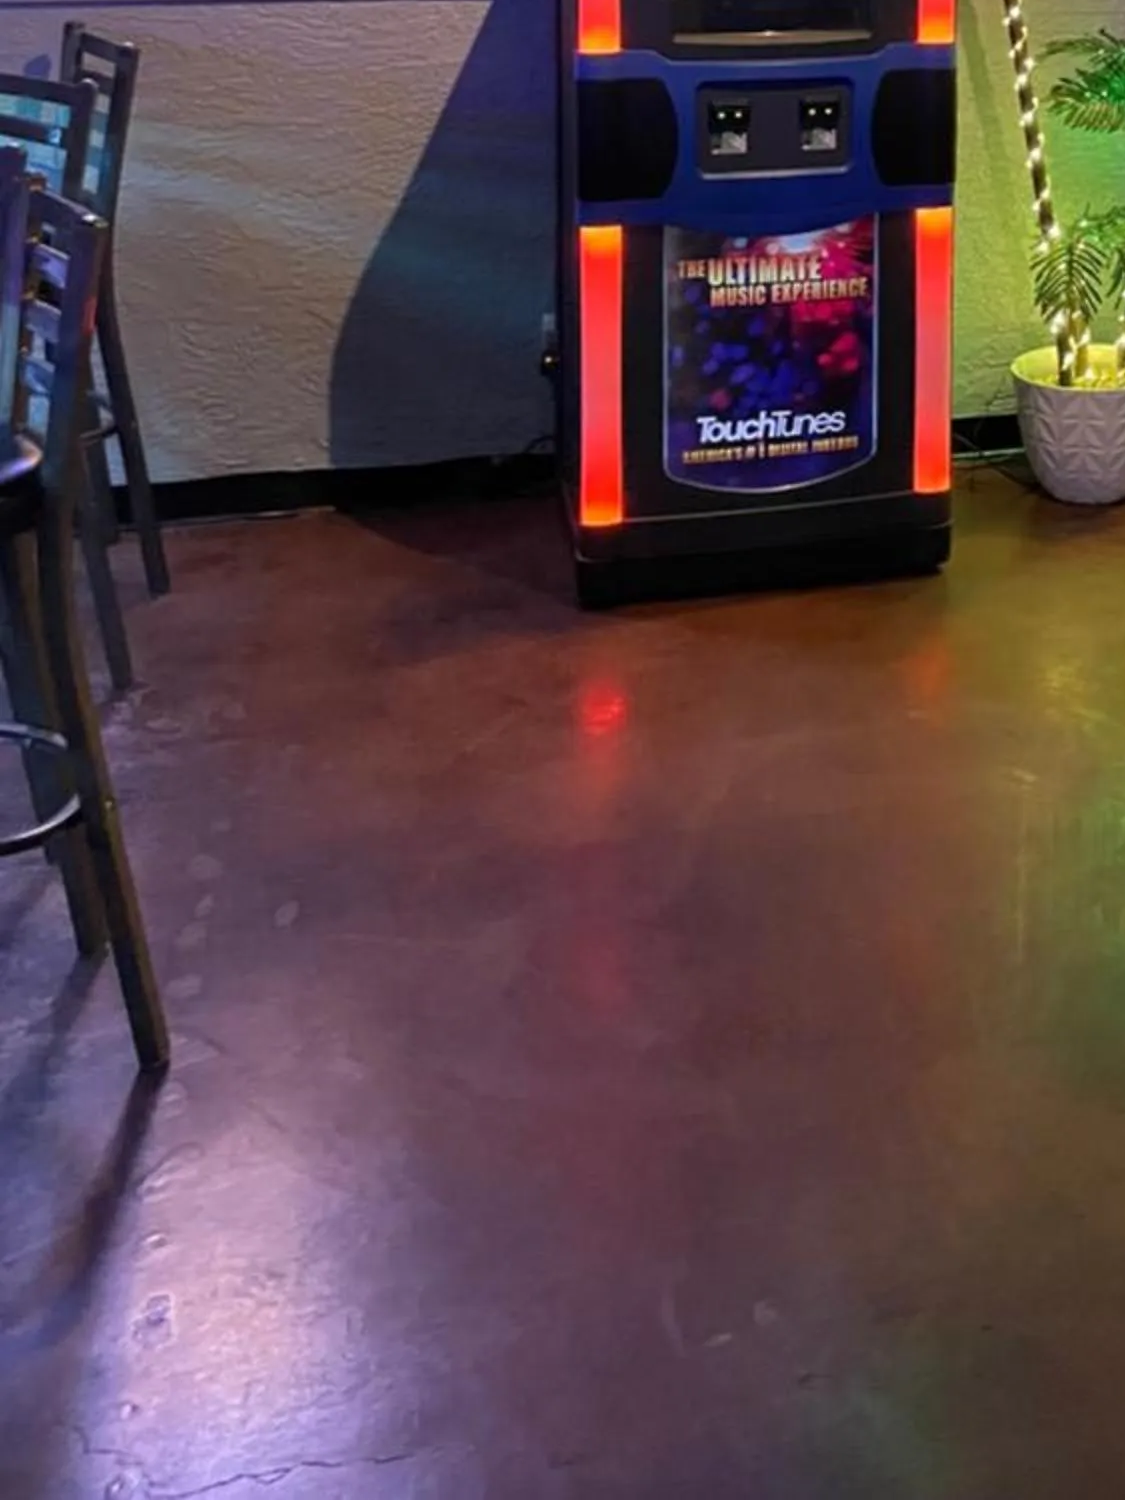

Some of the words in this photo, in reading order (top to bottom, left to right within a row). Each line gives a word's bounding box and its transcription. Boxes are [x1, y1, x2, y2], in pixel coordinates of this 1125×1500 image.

[677, 259, 706, 279] THE
[707, 255, 823, 286] ULTIMATE
[710, 284, 767, 308] MUSIC
[770, 276, 869, 303] EXPERIENCE
[697, 409, 846, 443] TouchTunes
